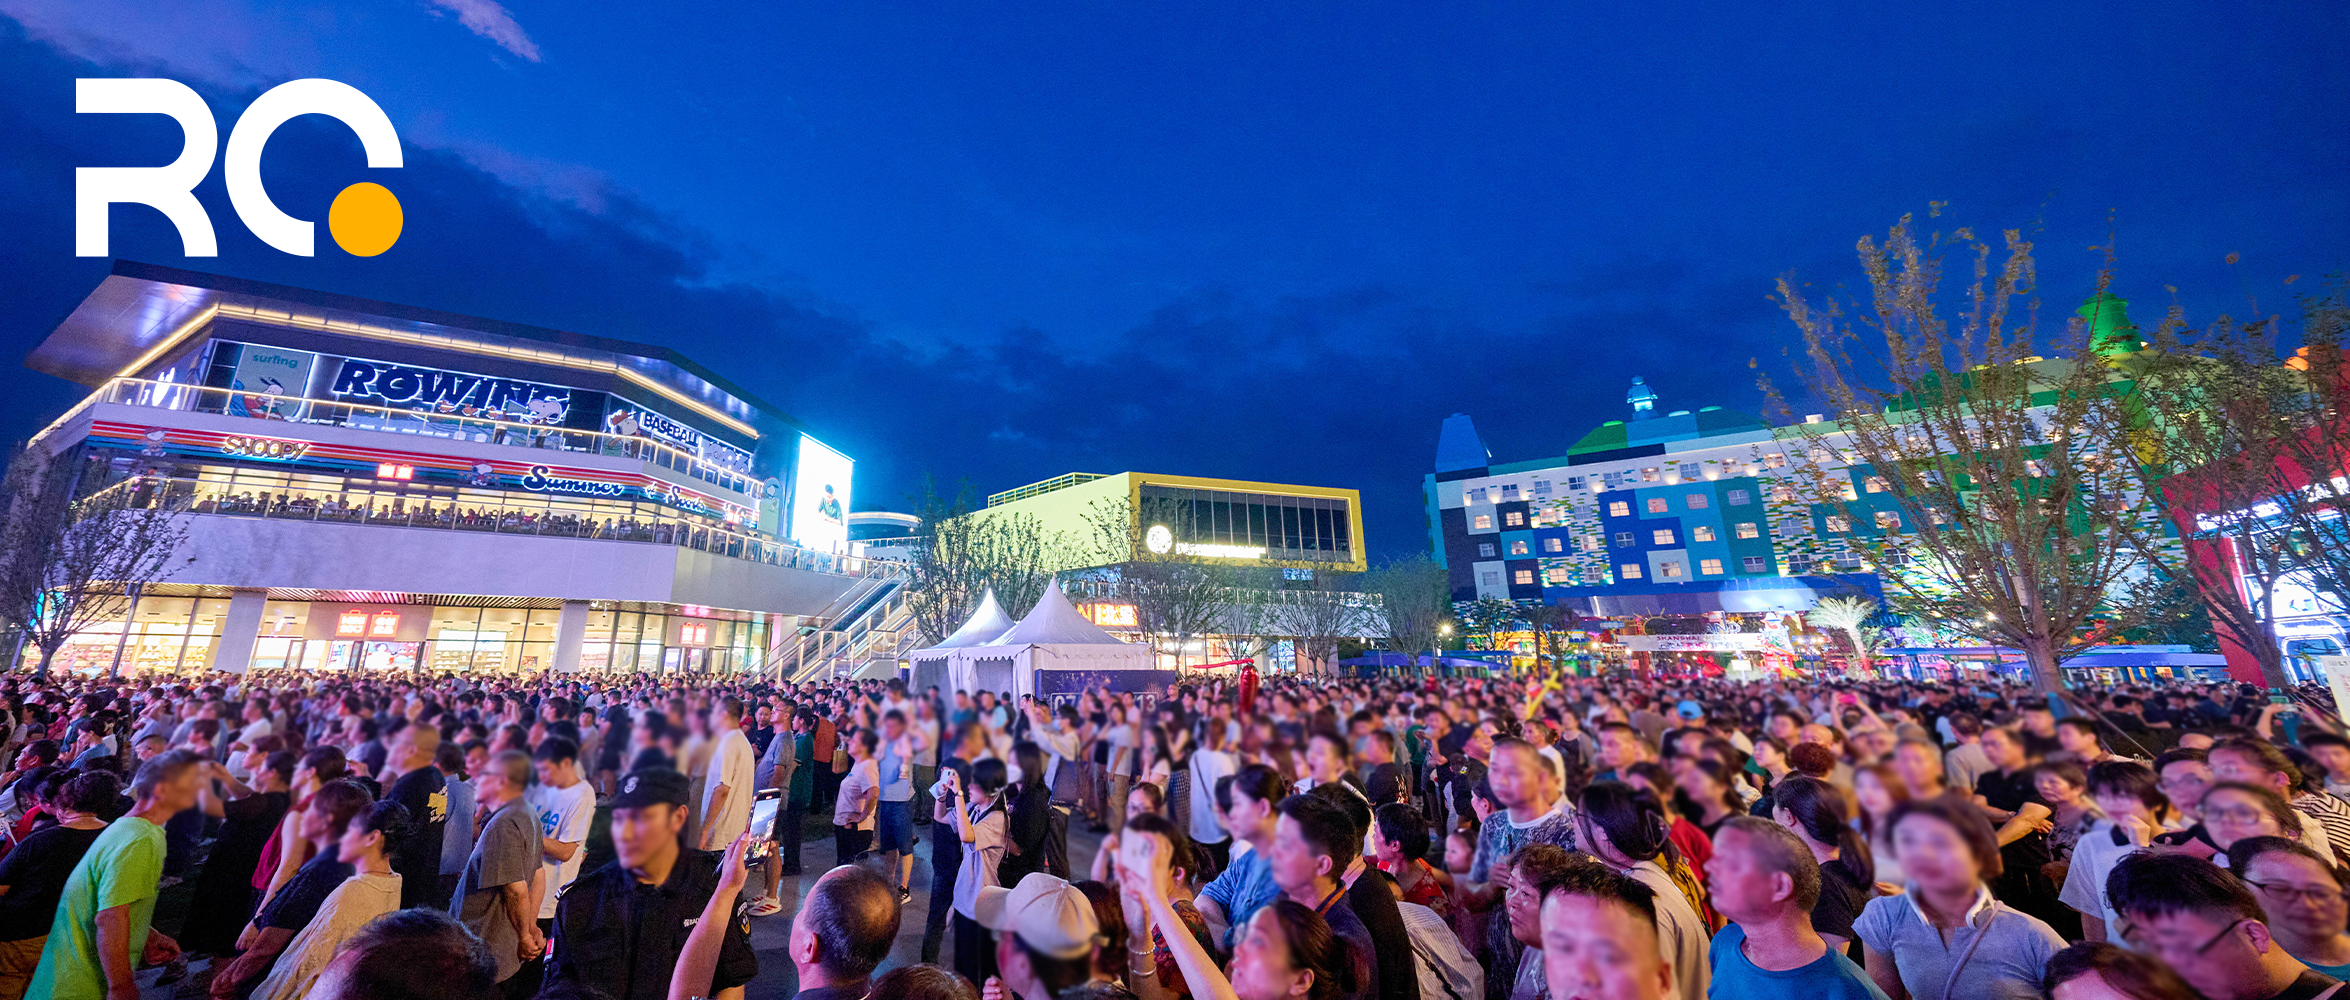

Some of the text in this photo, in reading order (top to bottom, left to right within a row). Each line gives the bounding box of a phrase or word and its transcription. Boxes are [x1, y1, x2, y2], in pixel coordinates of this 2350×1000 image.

[252, 354, 298, 369] surfing
[643, 411, 700, 447] BASEBALL
[222, 436, 309, 460] SNOOPY
[523, 465, 625, 496] Summer
[665, 486, 707, 513] Sports
[536, 804, 560, 836] ee
